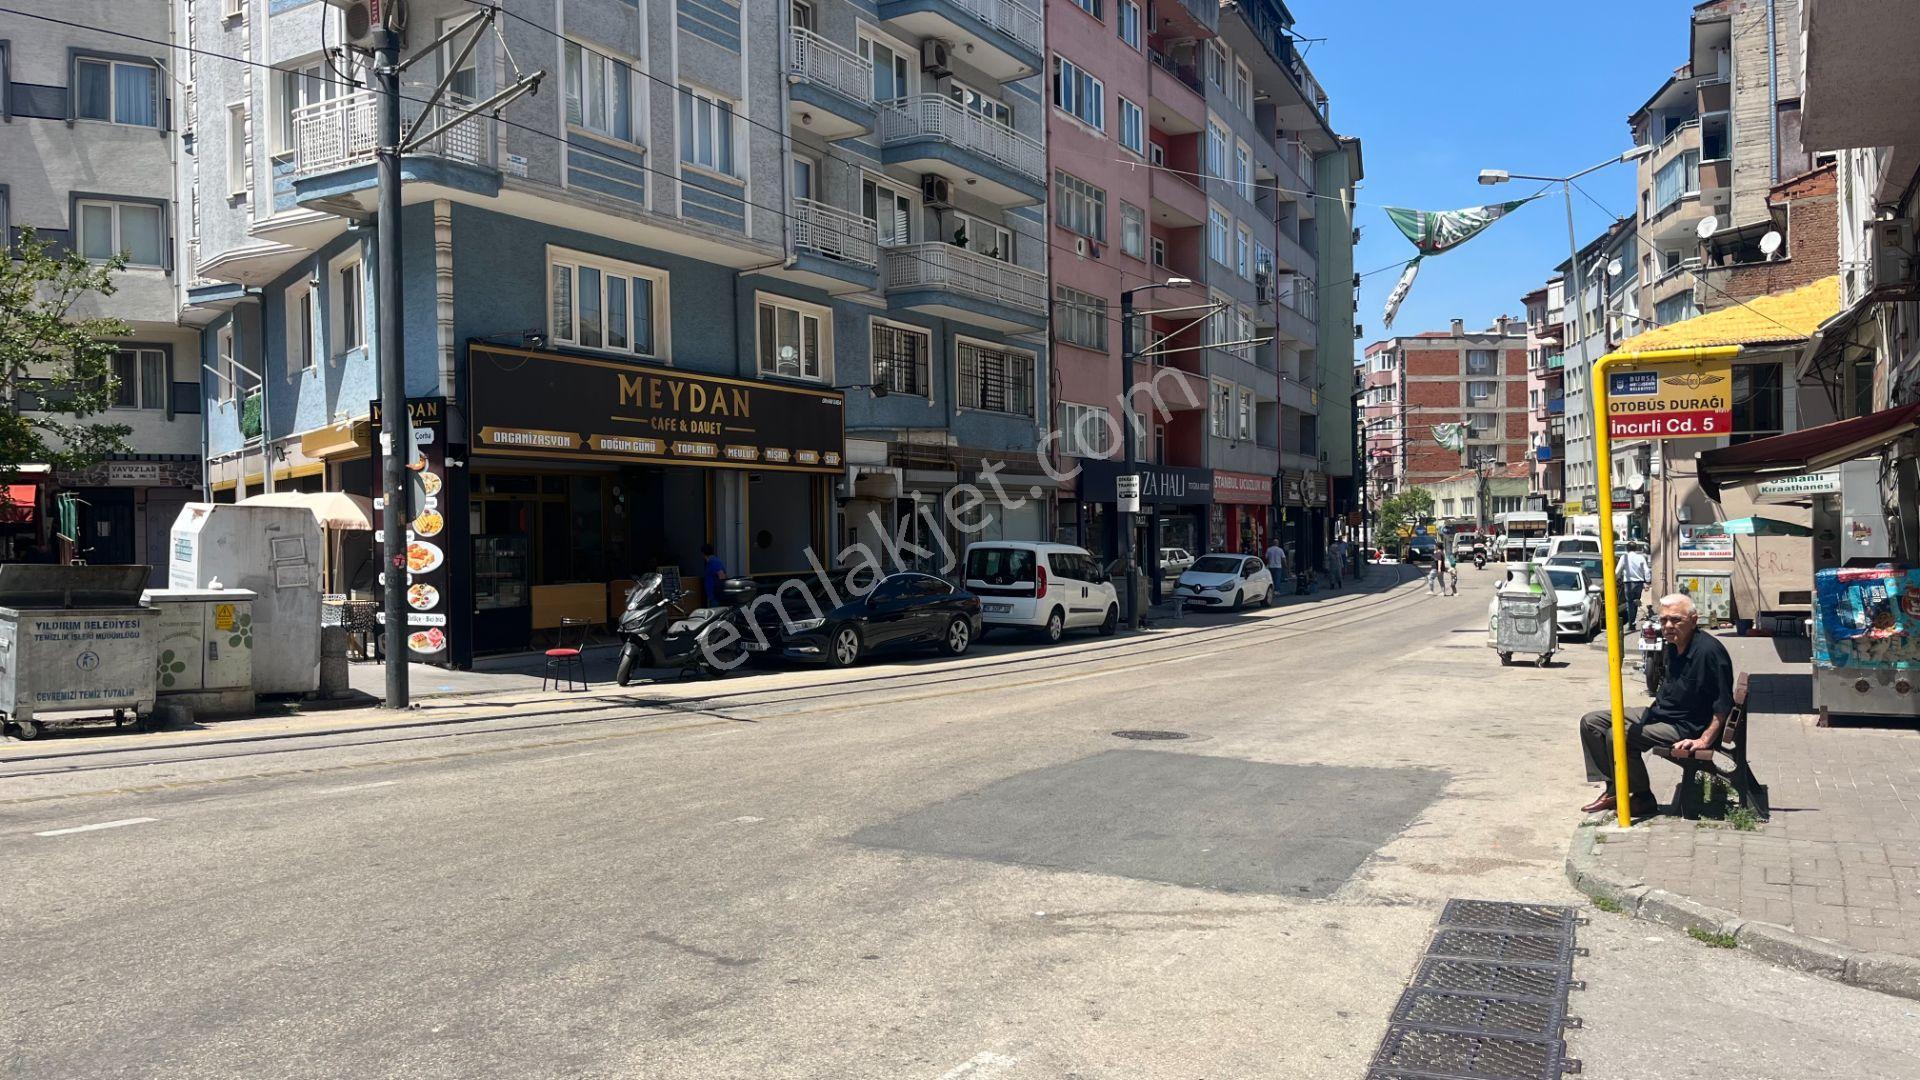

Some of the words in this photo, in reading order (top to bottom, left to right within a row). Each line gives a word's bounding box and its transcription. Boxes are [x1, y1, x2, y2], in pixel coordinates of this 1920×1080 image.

[616, 372, 751, 418] MEYDAN
[1610, 398, 1666, 413] OTOBÜS
[1669, 395, 1724, 410] DURAĞI
[650, 416, 678, 432] CAFE
[679, 419, 688, 433] &
[1666, 417, 1697, 432] Cd.
[1703, 417, 1714, 431] 5
[493, 431, 571, 447] ORGANİZASYON
[600, 436, 631, 450] DOĞUM
[632, 439, 657, 453] GÜNÜ
[677, 443, 714, 455] TOPLANTI
[1143, 471, 1157, 496] ZA
[1161, 473, 1185, 497] HALI
[1761, 482, 1833, 493] Kıraathanesi
[35, 621, 81, 631] YILDIRIM
[103, 687, 135, 698] TUTALIM
